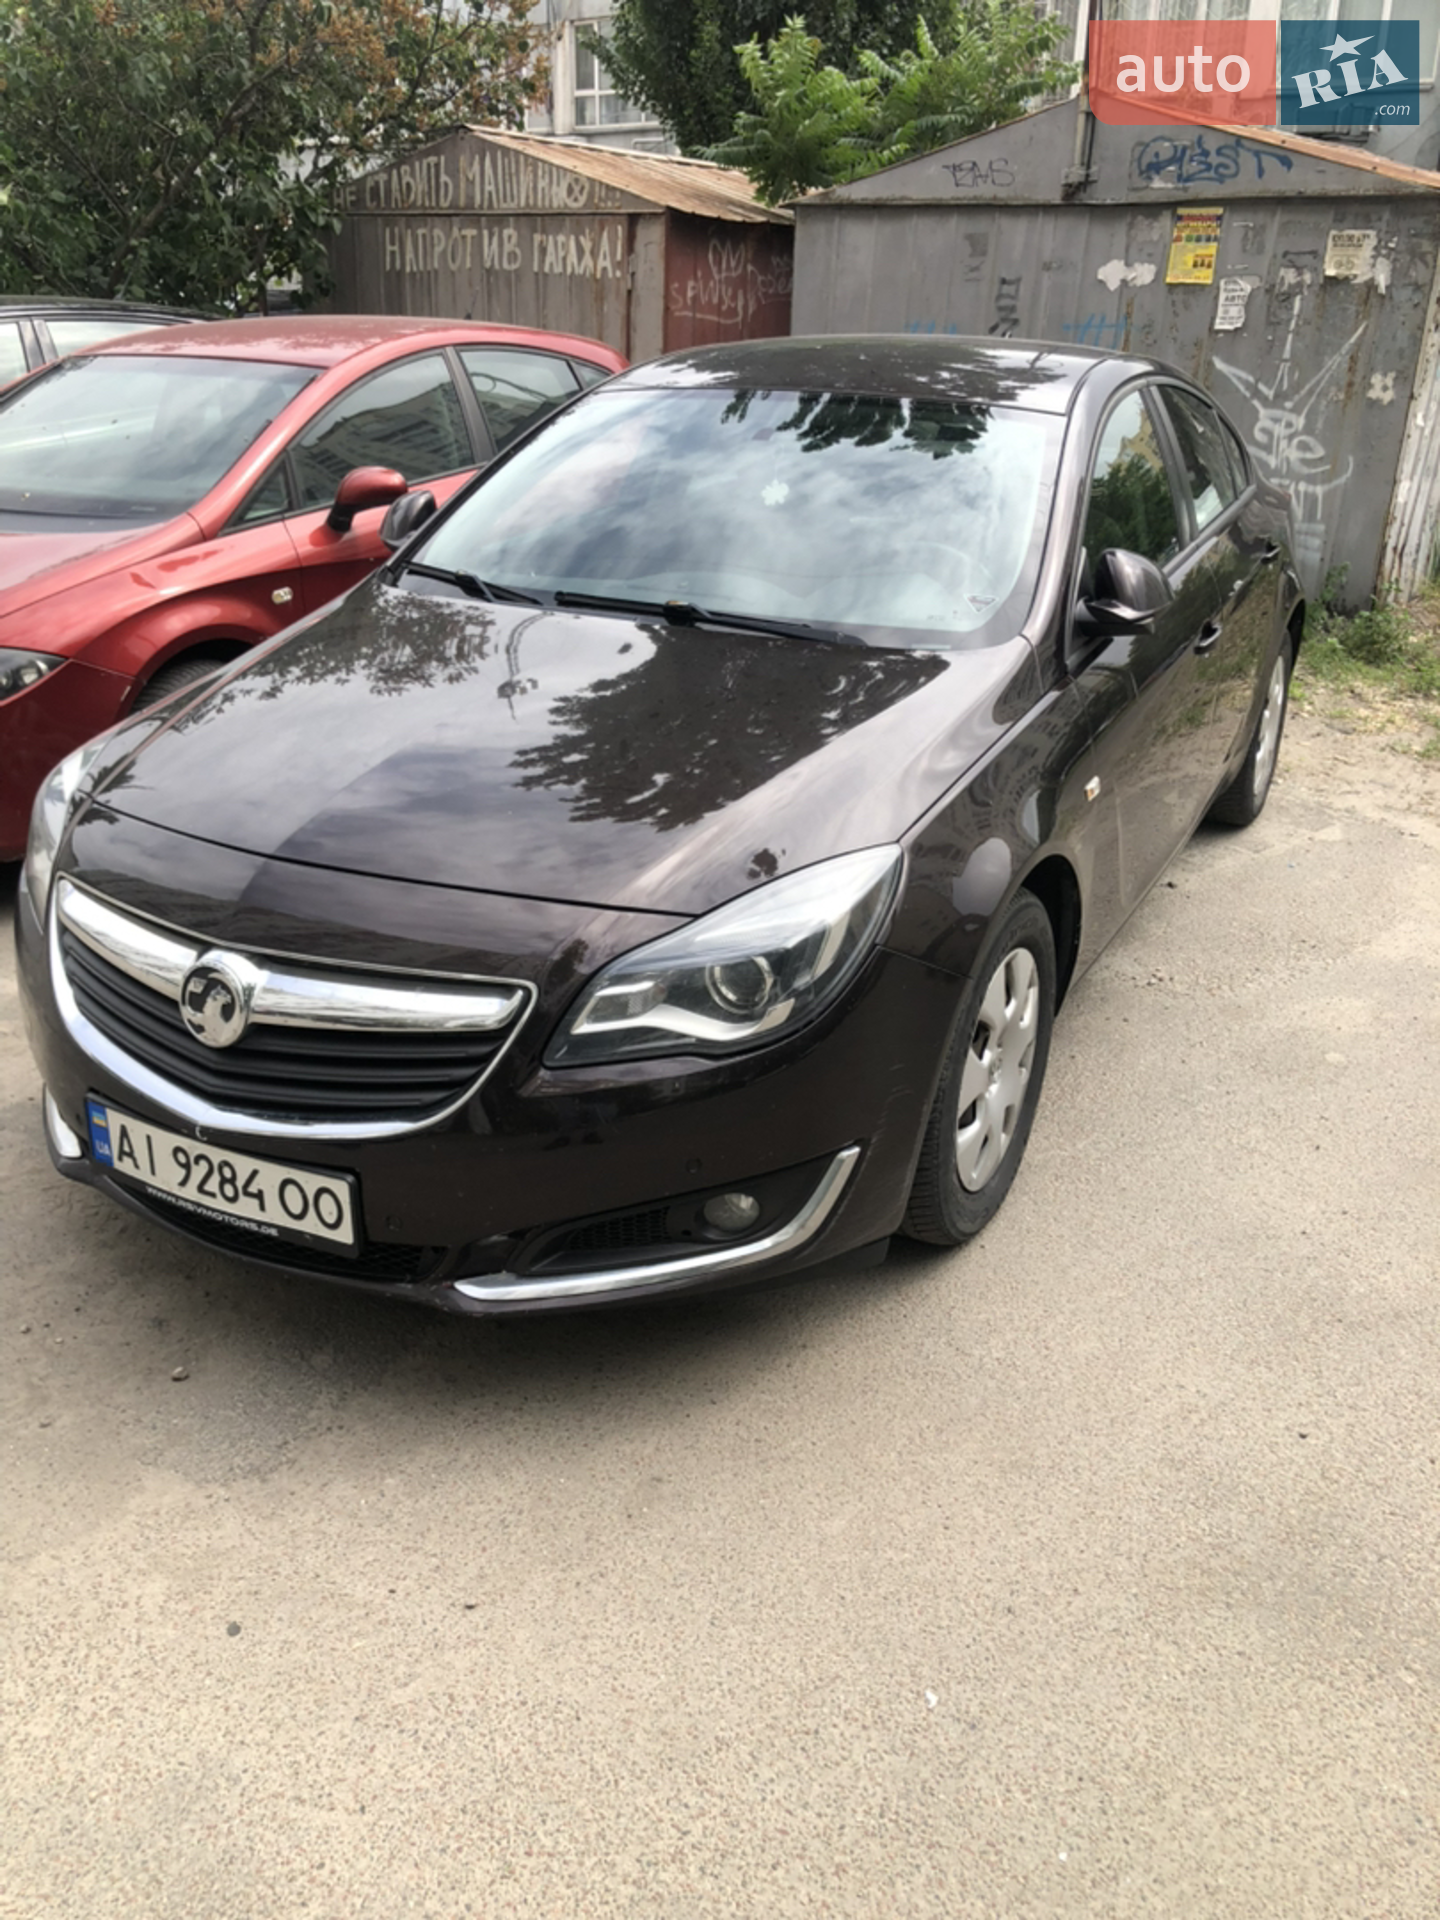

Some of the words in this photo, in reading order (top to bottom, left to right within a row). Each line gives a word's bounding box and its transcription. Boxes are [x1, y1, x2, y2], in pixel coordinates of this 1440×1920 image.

[365, 155, 453, 209] СТАВИТЬ
[385, 226, 522, 273] НАПРОТИВ
[532, 224, 624, 279] ГАРАЖА!
[117, 1124, 156, 1177] AI
[171, 1145, 266, 1213] 9284
